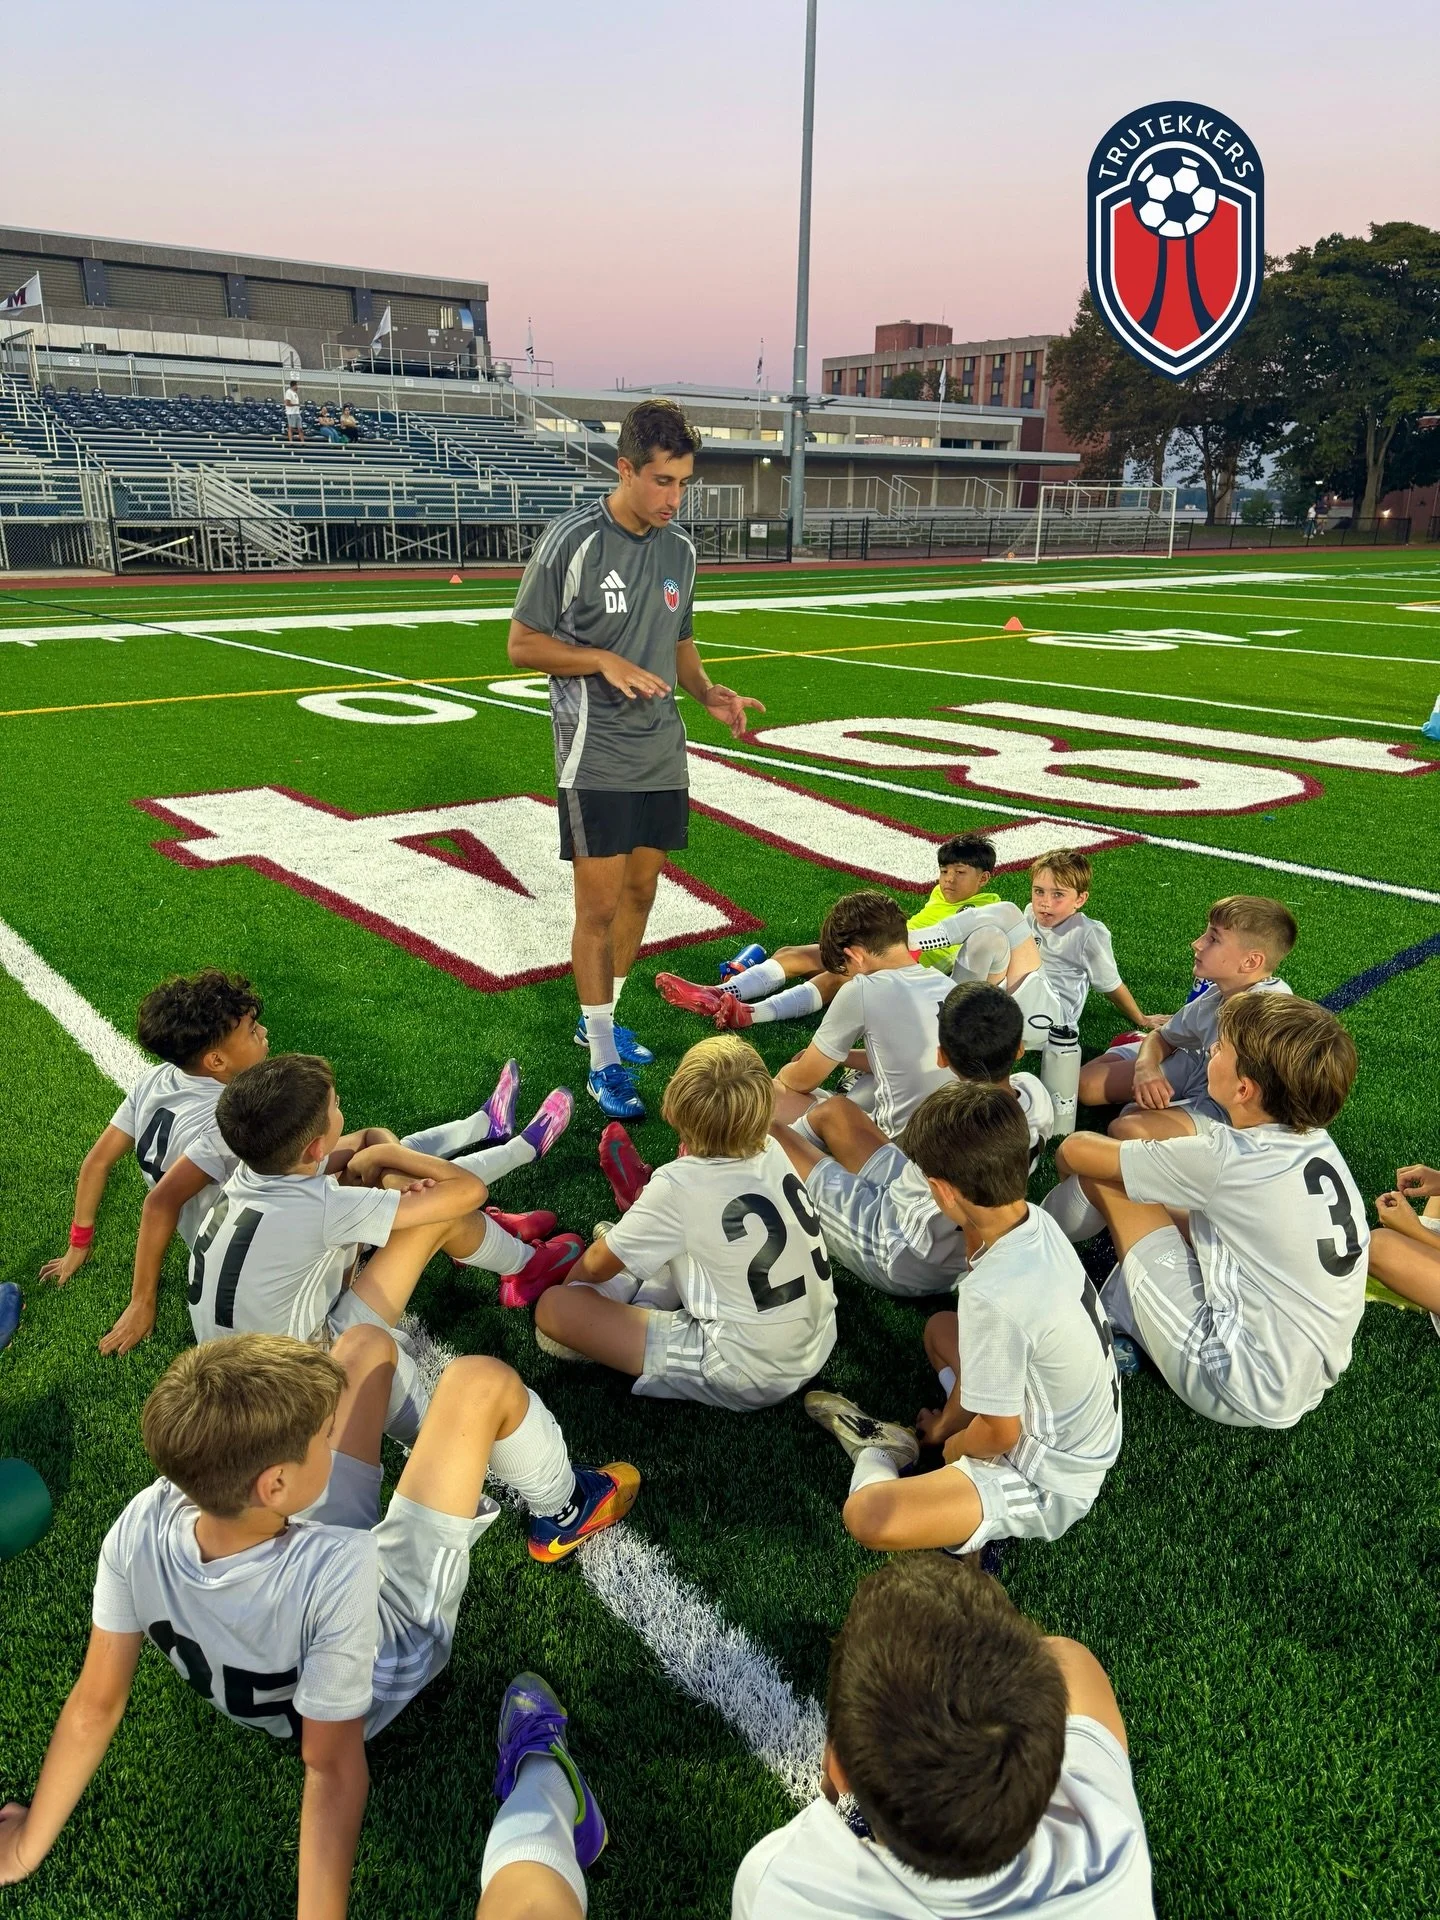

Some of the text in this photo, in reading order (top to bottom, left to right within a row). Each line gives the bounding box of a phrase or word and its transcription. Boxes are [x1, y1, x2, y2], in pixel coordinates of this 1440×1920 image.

[7, 287, 27, 307] M
[604, 591, 628, 614] DA
[721, 1173, 832, 1313] 29
[1302, 1157, 1363, 1278] 3
